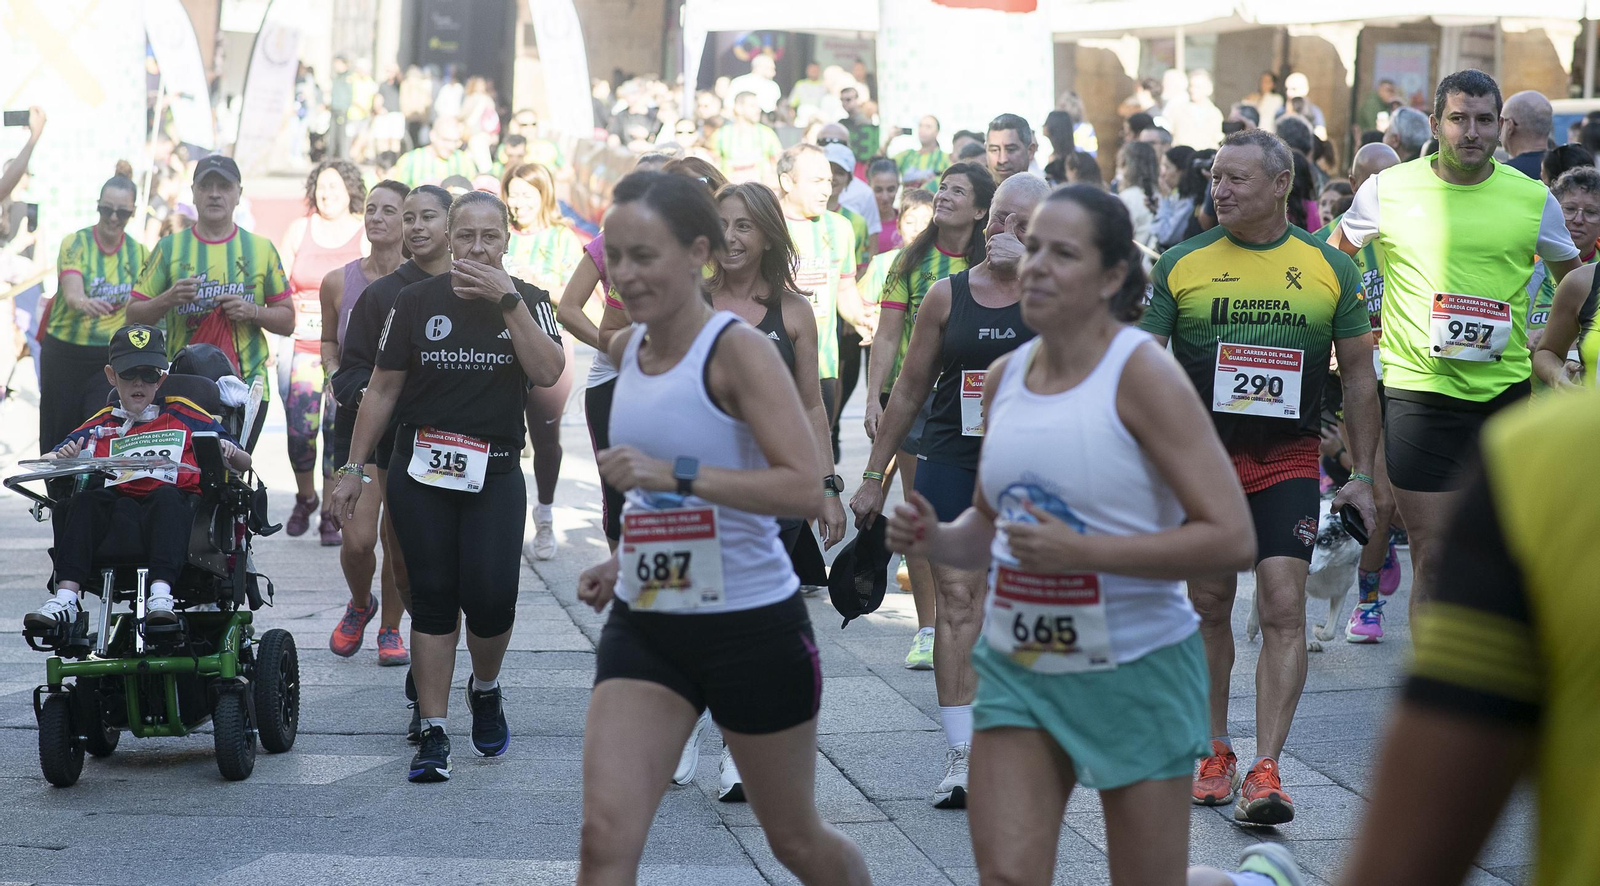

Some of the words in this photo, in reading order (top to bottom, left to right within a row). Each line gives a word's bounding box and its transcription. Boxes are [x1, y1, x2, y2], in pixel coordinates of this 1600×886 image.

[197, 282, 244, 299] ARRERA
[1233, 299, 1290, 310] CARRERA
[1230, 311, 1307, 327] SOLIDARIA
[1531, 312, 1550, 324] GU
[978, 327, 1017, 339] FILA
[1448, 320, 1495, 344] 957
[420, 348, 514, 365] patoblanco
[1275, 359, 1298, 367] OURENSE
[436, 363, 494, 371] CELANOVA
[1233, 373, 1284, 397] 290
[464, 439, 486, 449] OURENSE
[429, 449, 468, 472] 315
[636, 551, 692, 582] 687
[1013, 612, 1077, 645] 665
